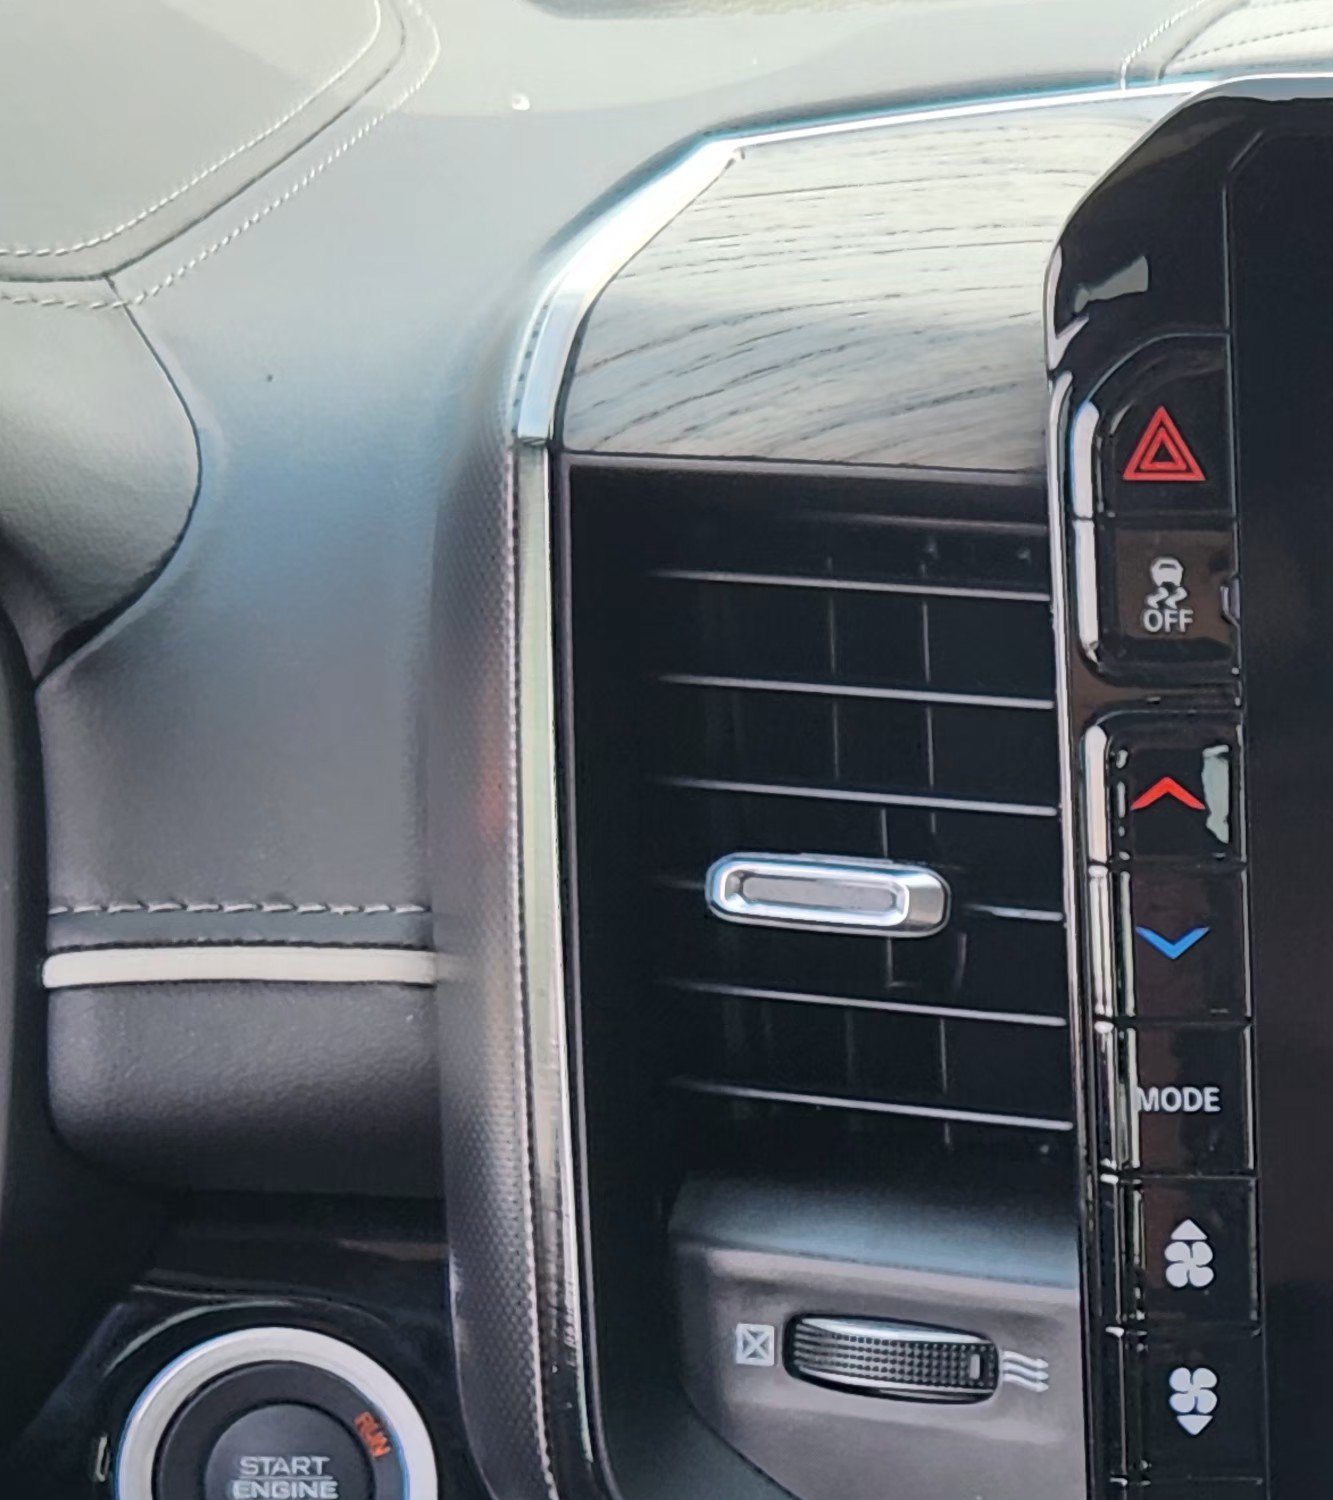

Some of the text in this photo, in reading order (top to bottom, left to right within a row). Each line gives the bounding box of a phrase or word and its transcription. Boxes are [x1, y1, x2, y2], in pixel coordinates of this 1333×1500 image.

[1142, 609, 1193, 633] OFF
[1136, 1086, 1221, 1112] MODE
[240, 1456, 330, 1476] START
[232, 1480, 339, 1500] ENGINE
